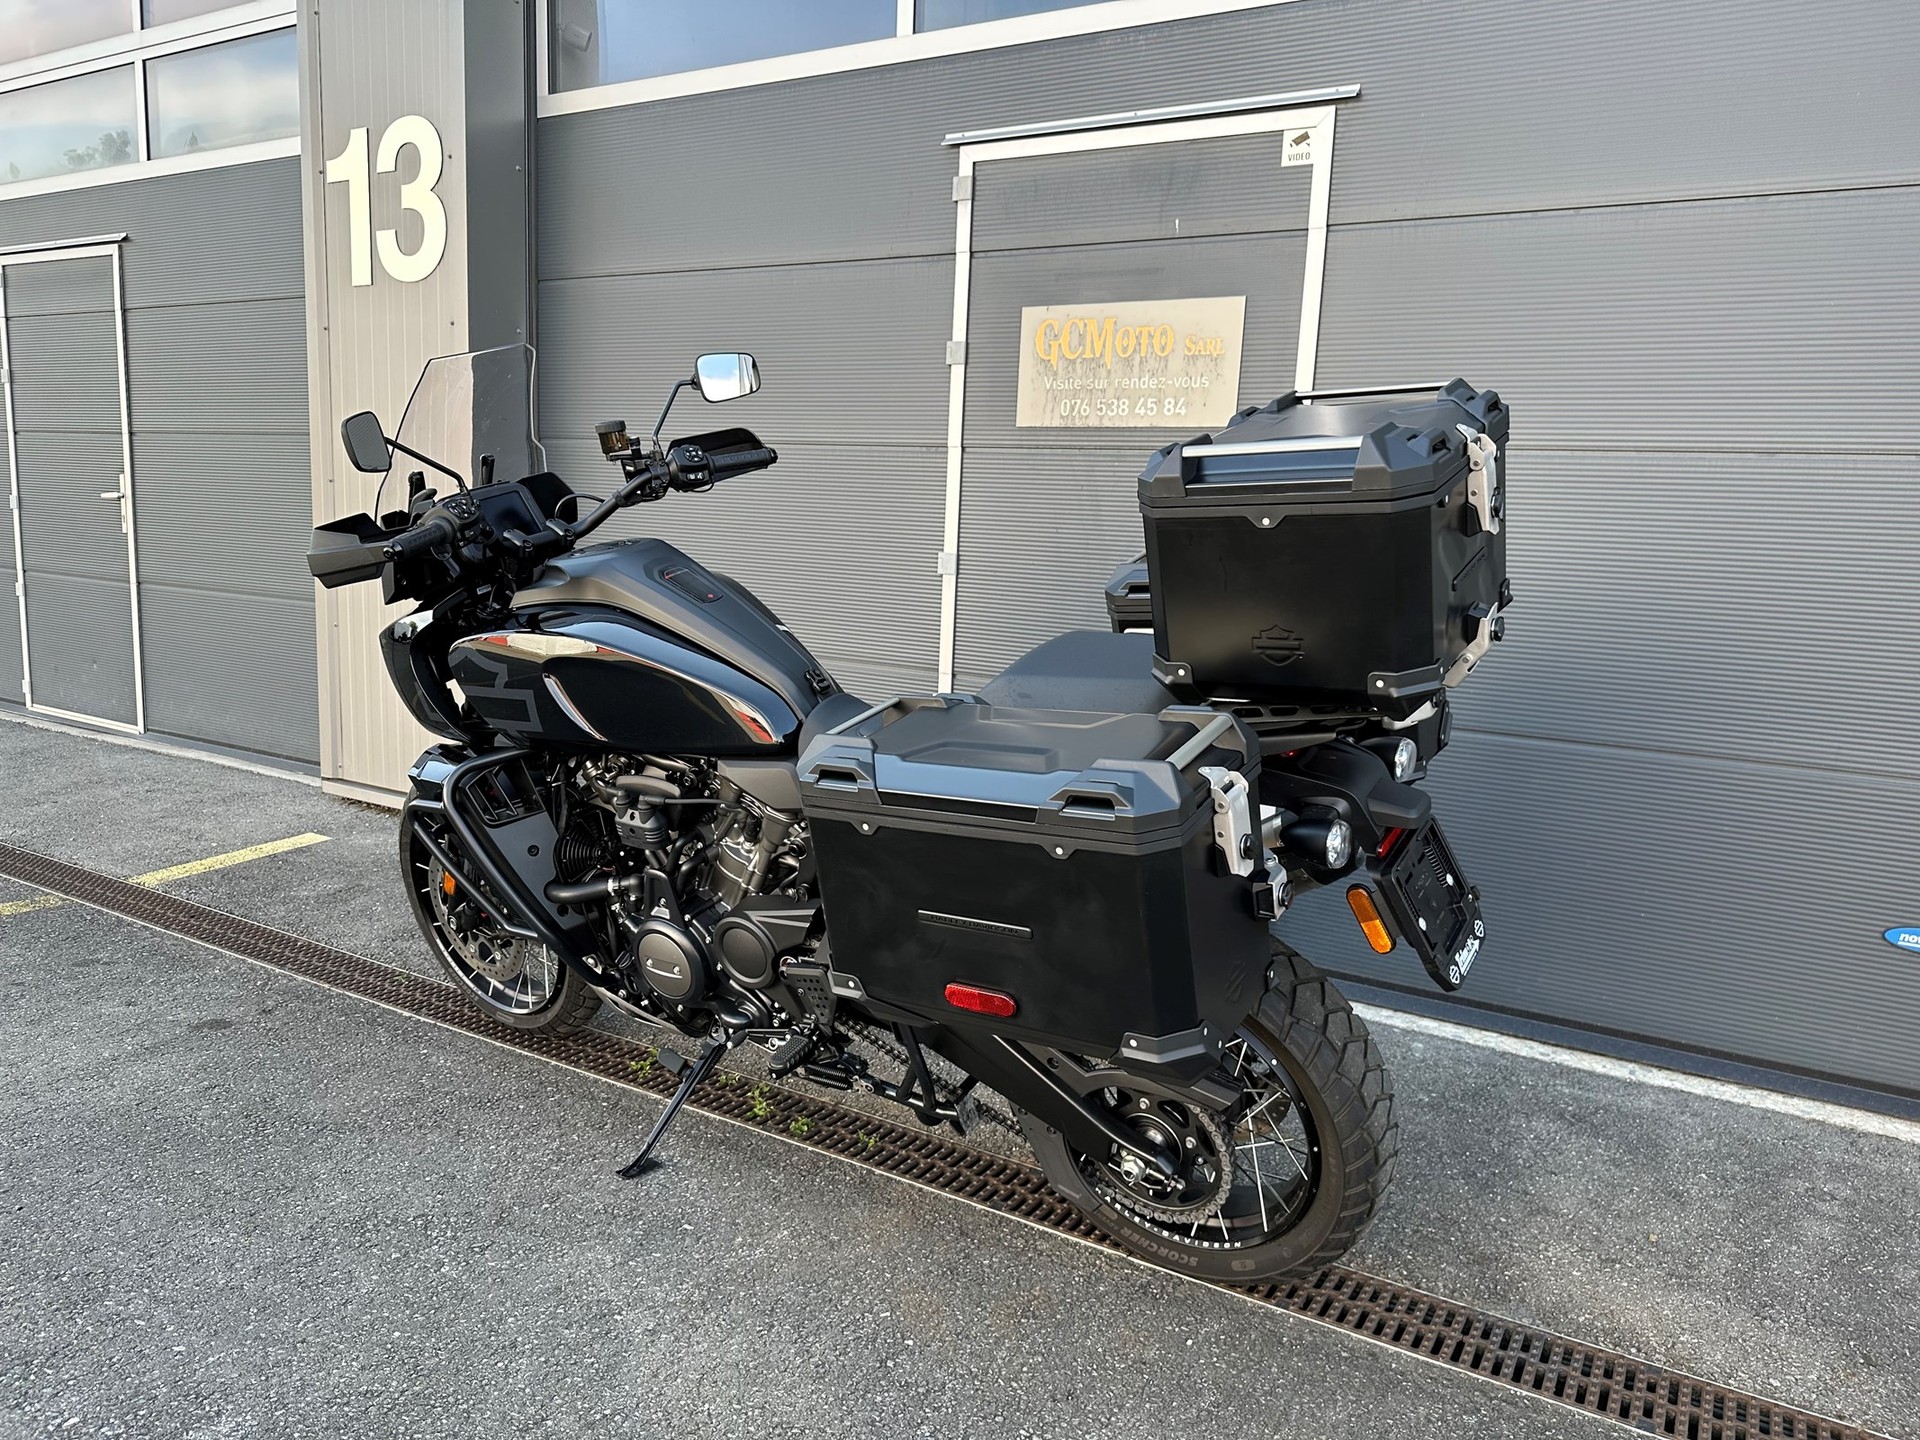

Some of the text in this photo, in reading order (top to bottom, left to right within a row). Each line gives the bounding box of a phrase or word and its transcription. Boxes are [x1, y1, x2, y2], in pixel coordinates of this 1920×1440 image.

[1288, 152, 1310, 161] VIDEO
[326, 115, 448, 287] 13
[1044, 373, 1210, 390] Visite sur rendez-vous
[1060, 397, 1187, 416] 076 538 45 84
[1899, 932, 1920, 944] no
[1120, 1227, 1199, 1267] SCORCHER
